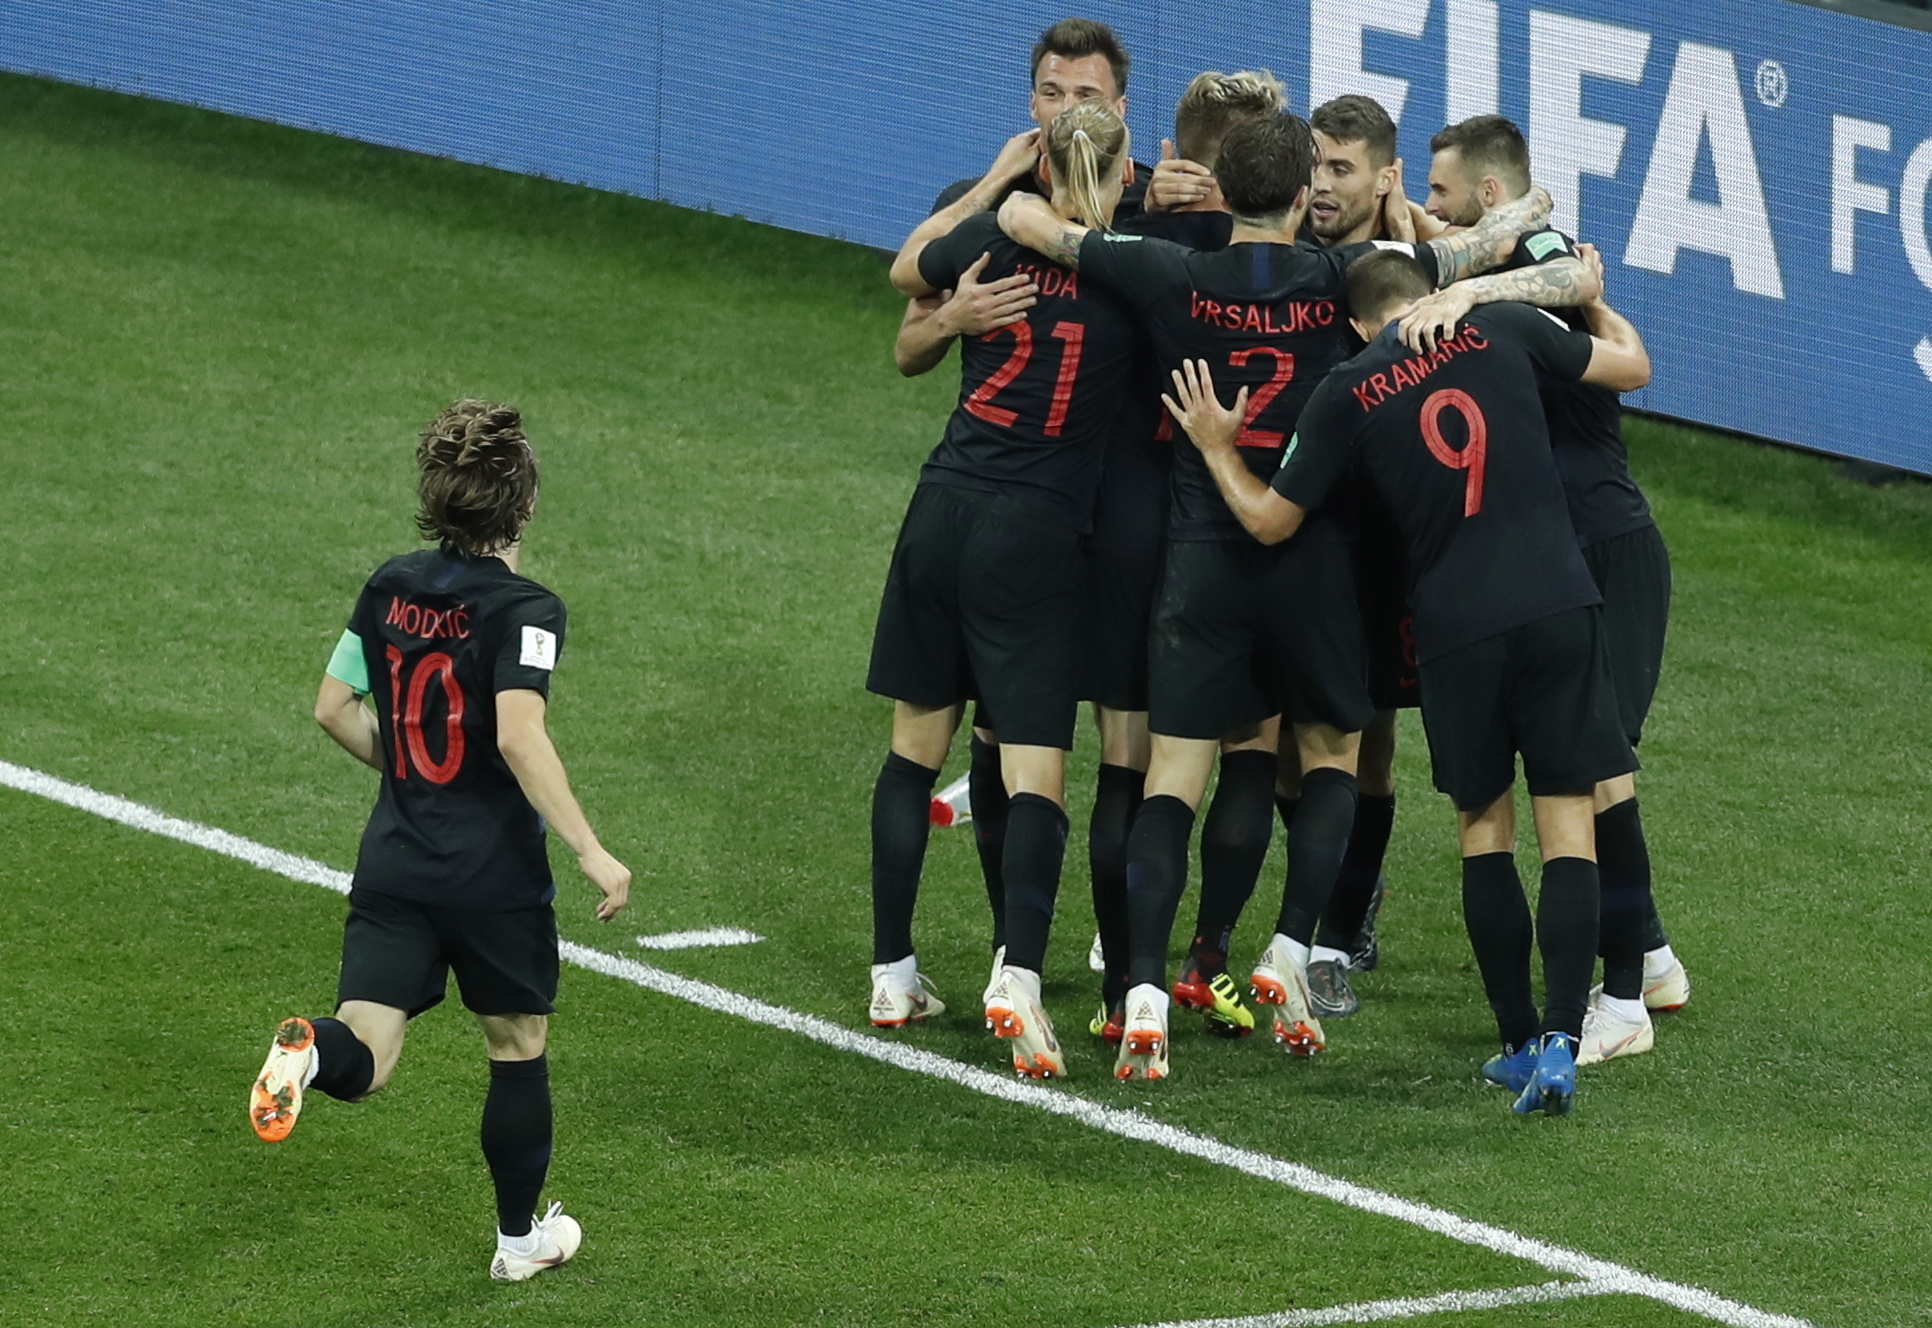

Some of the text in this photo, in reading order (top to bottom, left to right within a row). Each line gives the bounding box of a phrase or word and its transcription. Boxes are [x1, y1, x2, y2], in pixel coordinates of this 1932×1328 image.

[1190, 290, 1335, 333] VRSALJKO
[964, 319, 1085, 437] 21
[1229, 346, 1294, 448] 2
[1420, 388, 1486, 517] 9
[386, 643, 465, 784] 10
